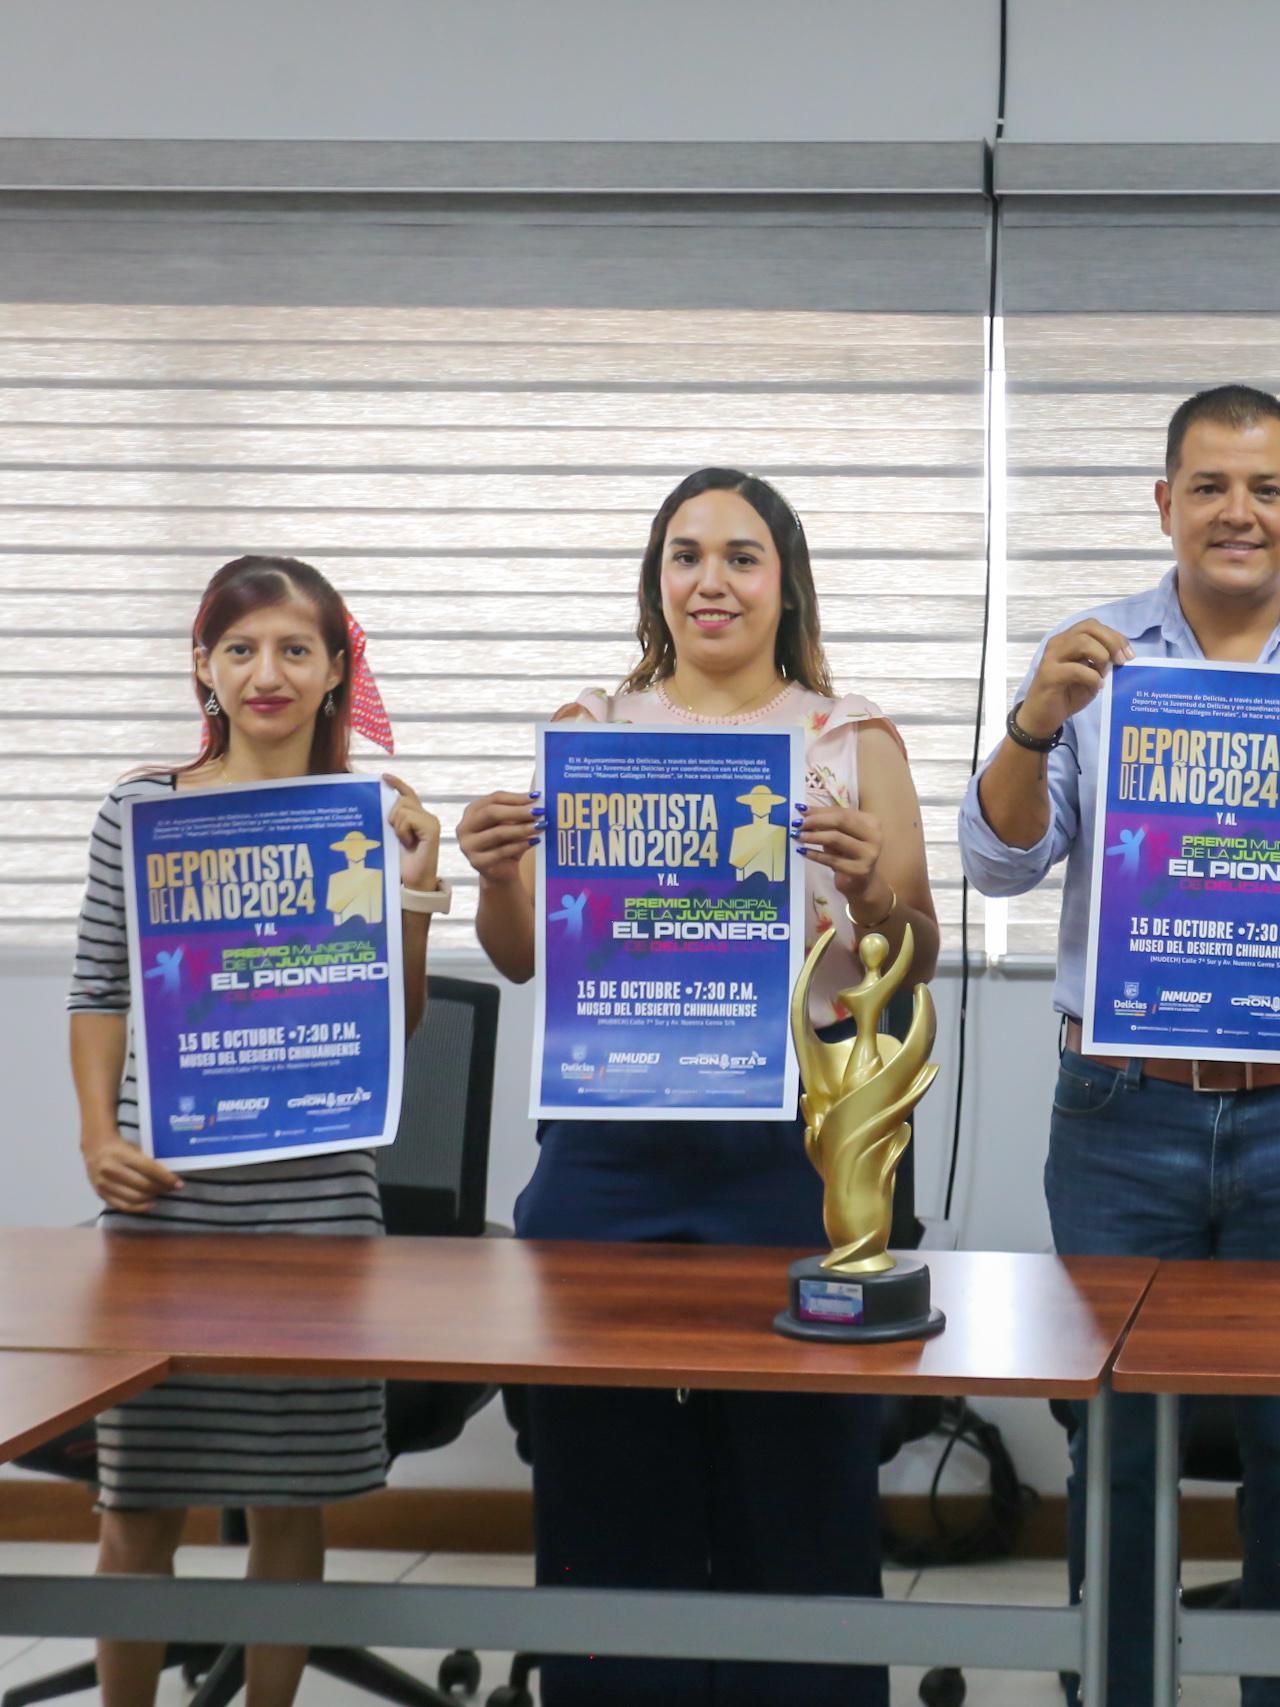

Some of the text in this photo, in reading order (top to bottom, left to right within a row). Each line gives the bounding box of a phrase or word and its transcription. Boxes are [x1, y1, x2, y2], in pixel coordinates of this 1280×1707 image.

[1121, 726, 1280, 771] DEPORTISTA
[557, 792, 718, 830] DEPORTISTA
[1216, 812, 1238, 825] Y AL
[1182, 835, 1247, 848] PREMIO
[1181, 847, 1204, 858] DE
[1207, 848, 1229, 860] LA
[1168, 858, 1204, 877] EL
[658, 873, 679, 886] Y AL
[624, 898, 777, 909] PREMIO MUNICIPAL
[624, 909, 777, 921] DE LA JUVENTUD
[612, 921, 789, 940] EL PIONERO
[1130, 917, 1148, 935] 15
[1152, 918, 1170, 936] DE
[1173, 919, 1233, 939] OCTUBRE
[1129, 938, 1163, 953] MUSEO
[1166, 940, 1184, 954] DEL
[1186, 941, 1233, 956] DESIERTO
[577, 980, 595, 998] 15
[599, 981, 616, 999] DE
[621, 981, 680, 999] OCTUBRE
[729, 982, 757, 1000] P.M.
[1160, 990, 1212, 1004] INMUDEJ
[577, 1002, 757, 1017] MUSEO DEL DESIERTO CHIHUAHUENSE
[1113, 999, 1147, 1009] Delicias
